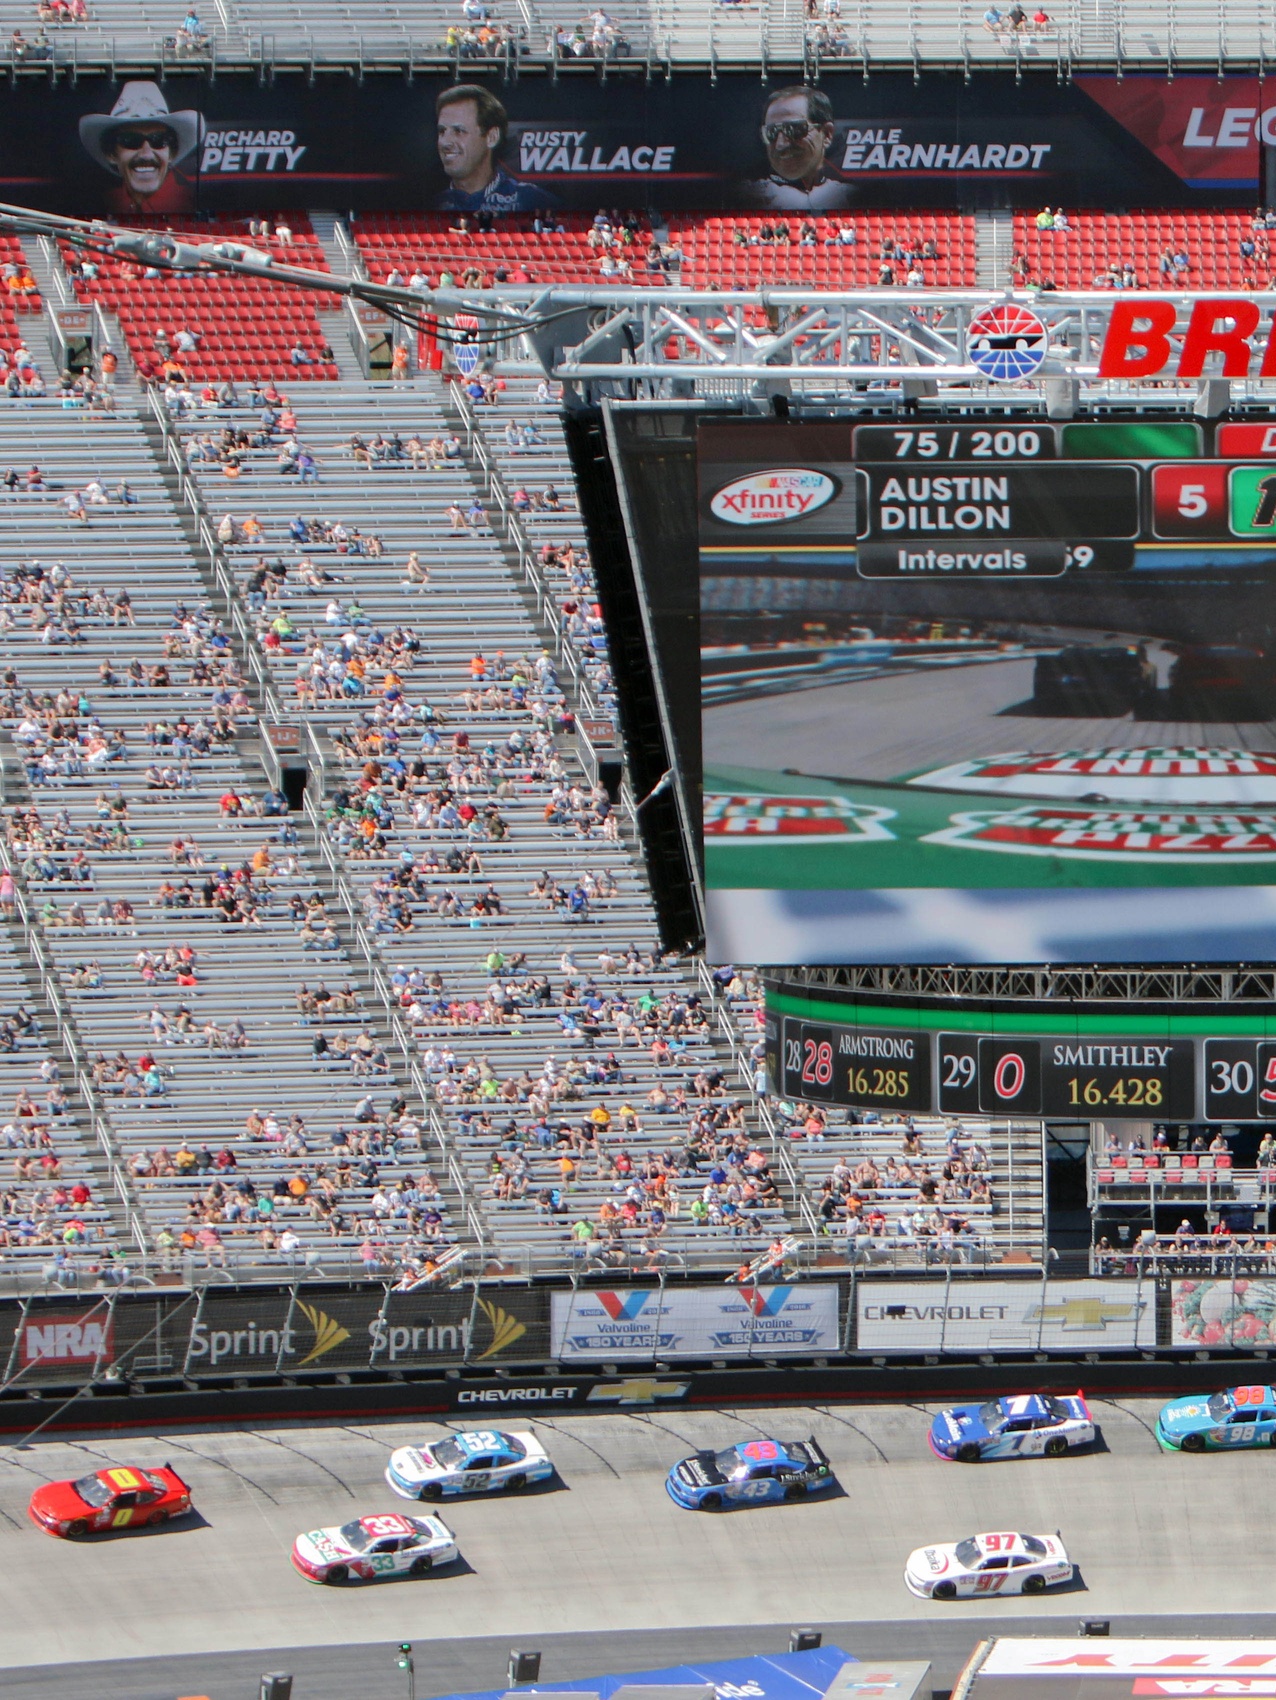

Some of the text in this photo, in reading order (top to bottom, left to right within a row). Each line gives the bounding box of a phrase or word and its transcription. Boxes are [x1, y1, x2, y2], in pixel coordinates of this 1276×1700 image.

[203, 131, 296, 148] RICHARD
[520, 131, 586, 148] RUSTY
[845, 128, 902, 144] DALE
[201, 146, 305, 172] PETTY
[519, 146, 675, 172] WALLACE
[841, 143, 1050, 170] EARNHARDT
[894, 431, 1041, 458] 75 / 200
[879, 477, 1009, 501] AUSTIN
[721, 489, 815, 514] xfinity
[1177, 484, 1208, 519] 5
[881, 506, 1011, 531] DILLON
[898, 549, 1027, 571] Intervals
[785, 1038, 801, 1072] 28
[839, 1033, 914, 1060] ARMSTRONG
[1054, 1044, 1173, 1068] SMITHLEY
[801, 1038, 833, 1086] 28
[942, 1054, 976, 1088] 29
[846, 1066, 909, 1098] 16.285
[992, 1052, 1026, 1100] 0
[1210, 1060, 1254, 1095] 30
[1068, 1078, 1163, 1106] 16.428
[864, 1304, 1009, 1322] CHEVROLET
[369, 1317, 475, 1362] Sprint
[597, 1323, 651, 1334] Valvoline
[755, 1331, 804, 1343] YEARS
[26, 1323, 108, 1361] NRA
[190, 1323, 297, 1365] Sprint
[457, 1387, 577, 1403] CHEVROLET
[1006, 1395, 1031, 1415] 1
[1234, 1385, 1265, 1406] 98
[461, 1432, 501, 1452] 52
[1229, 1426, 1256, 1442] 98
[743, 1440, 779, 1461] 43
[462, 1472, 492, 1490] 52
[743, 1481, 771, 1498] 43
[364, 1515, 405, 1535] 33
[985, 1533, 1017, 1552] 97
[370, 1554, 396, 1572] 33
[973, 1572, 1009, 1593] 97
